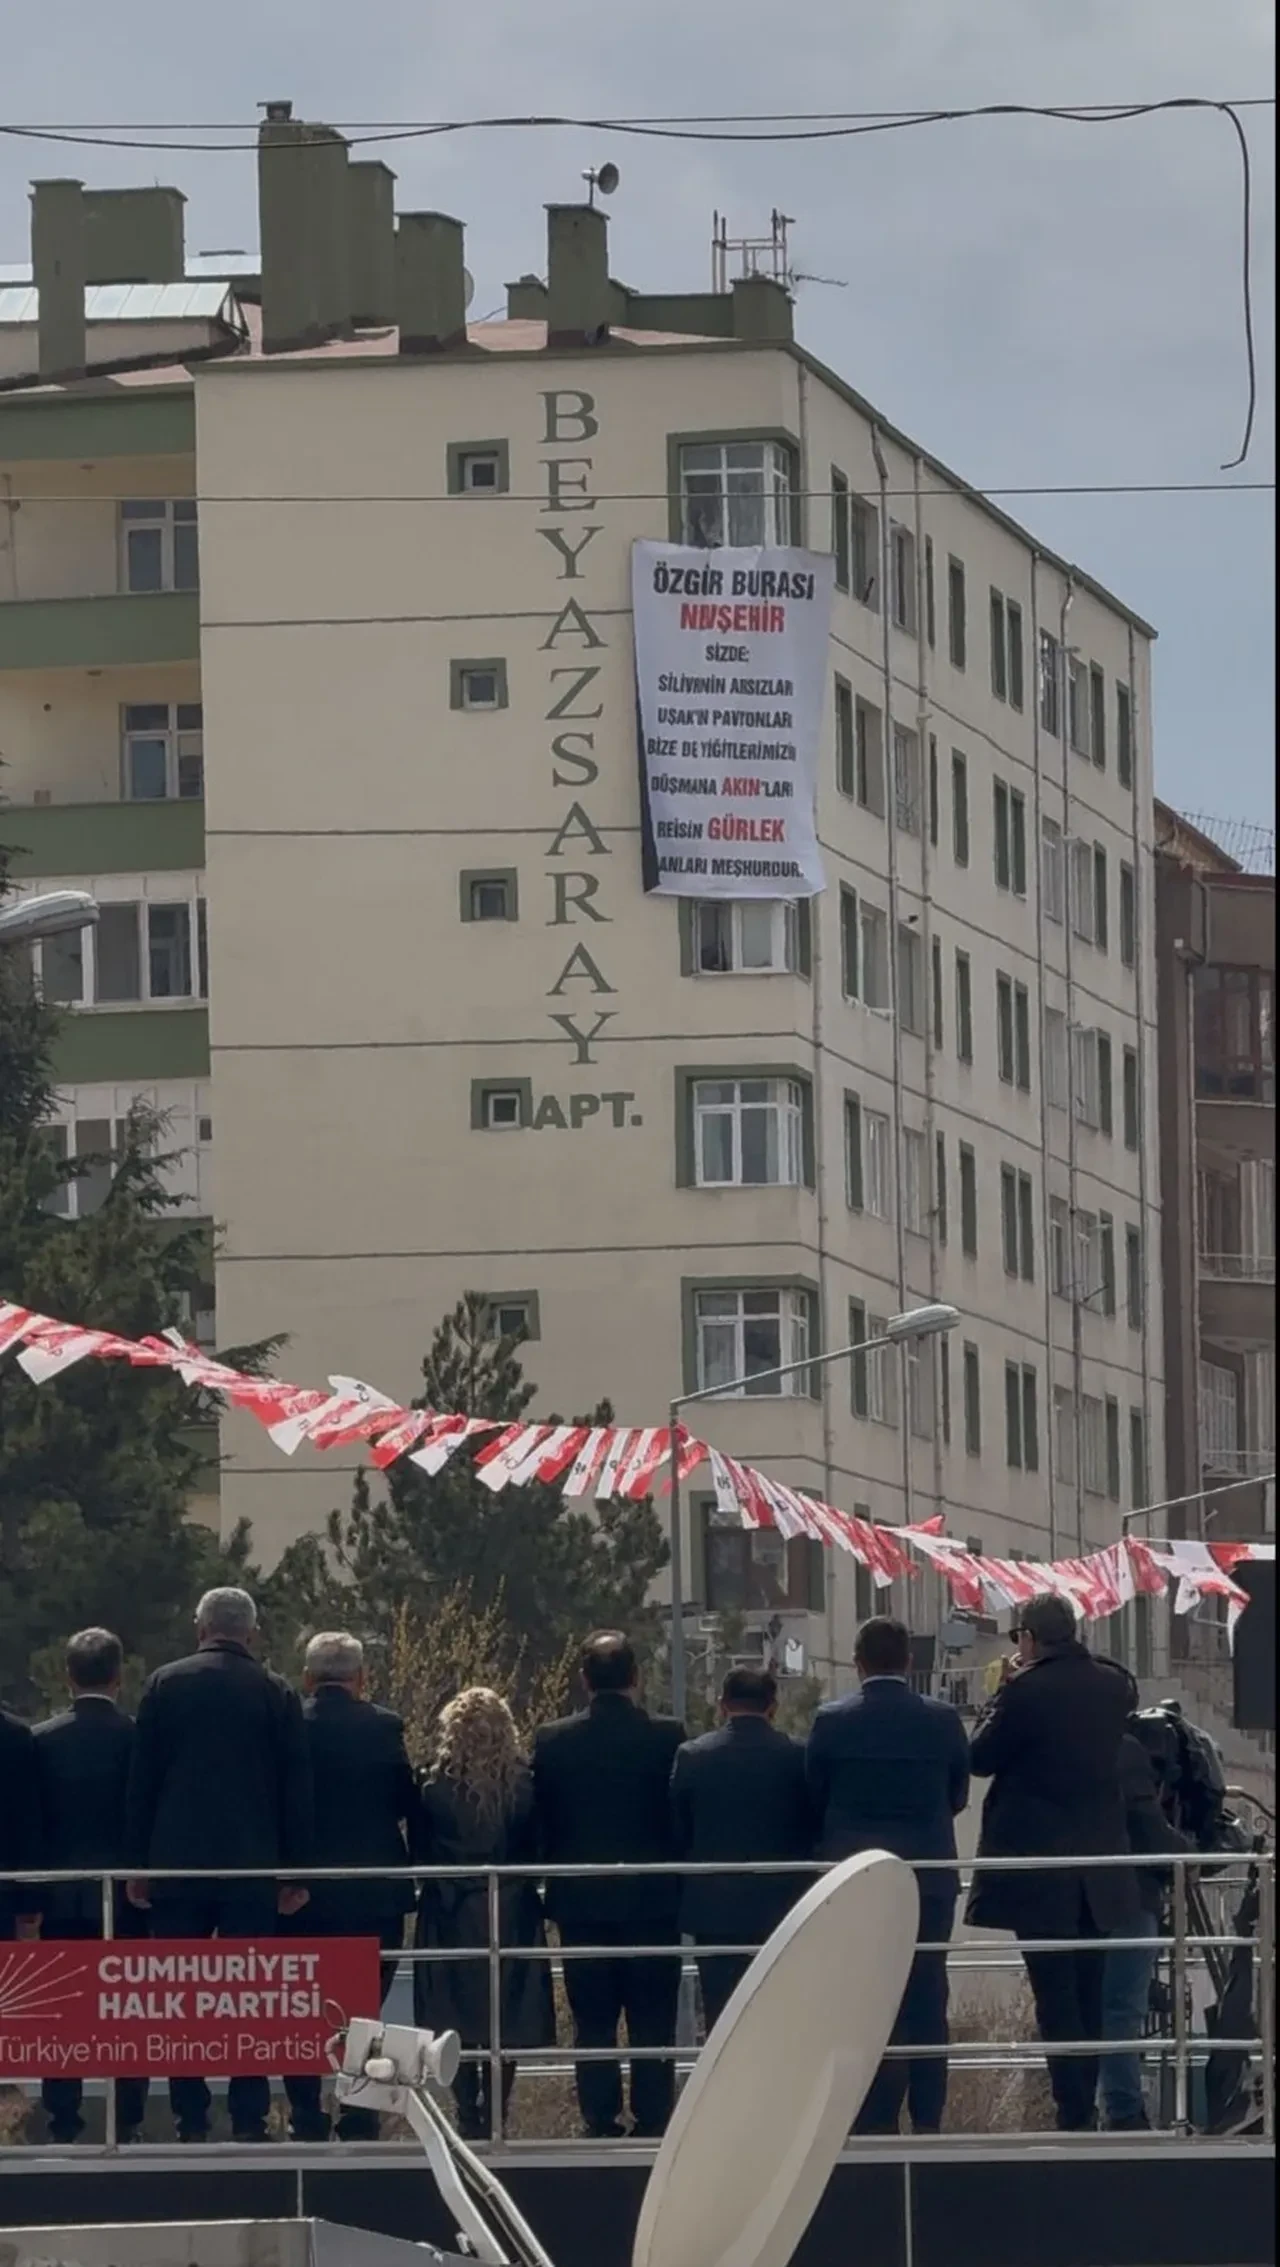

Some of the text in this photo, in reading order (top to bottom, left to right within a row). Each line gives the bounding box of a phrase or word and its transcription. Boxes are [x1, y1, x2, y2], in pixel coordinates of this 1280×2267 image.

[731, 569, 815, 601] BURASI
[537, 389, 618, 1066] BEYAZSARAY
[647, 736, 677, 757] BİZE
[681, 740, 699, 758] DE
[657, 813, 785, 843] REİSİN GÜRLEK
[532, 1091, 643, 1131] APT.
[98, 1946, 320, 1983] CUMHURİYET
[98, 1982, 321, 2020] HALK PARTİSİ
[0, 2031, 321, 2070] Türkiye'nin Birinci Partisi
